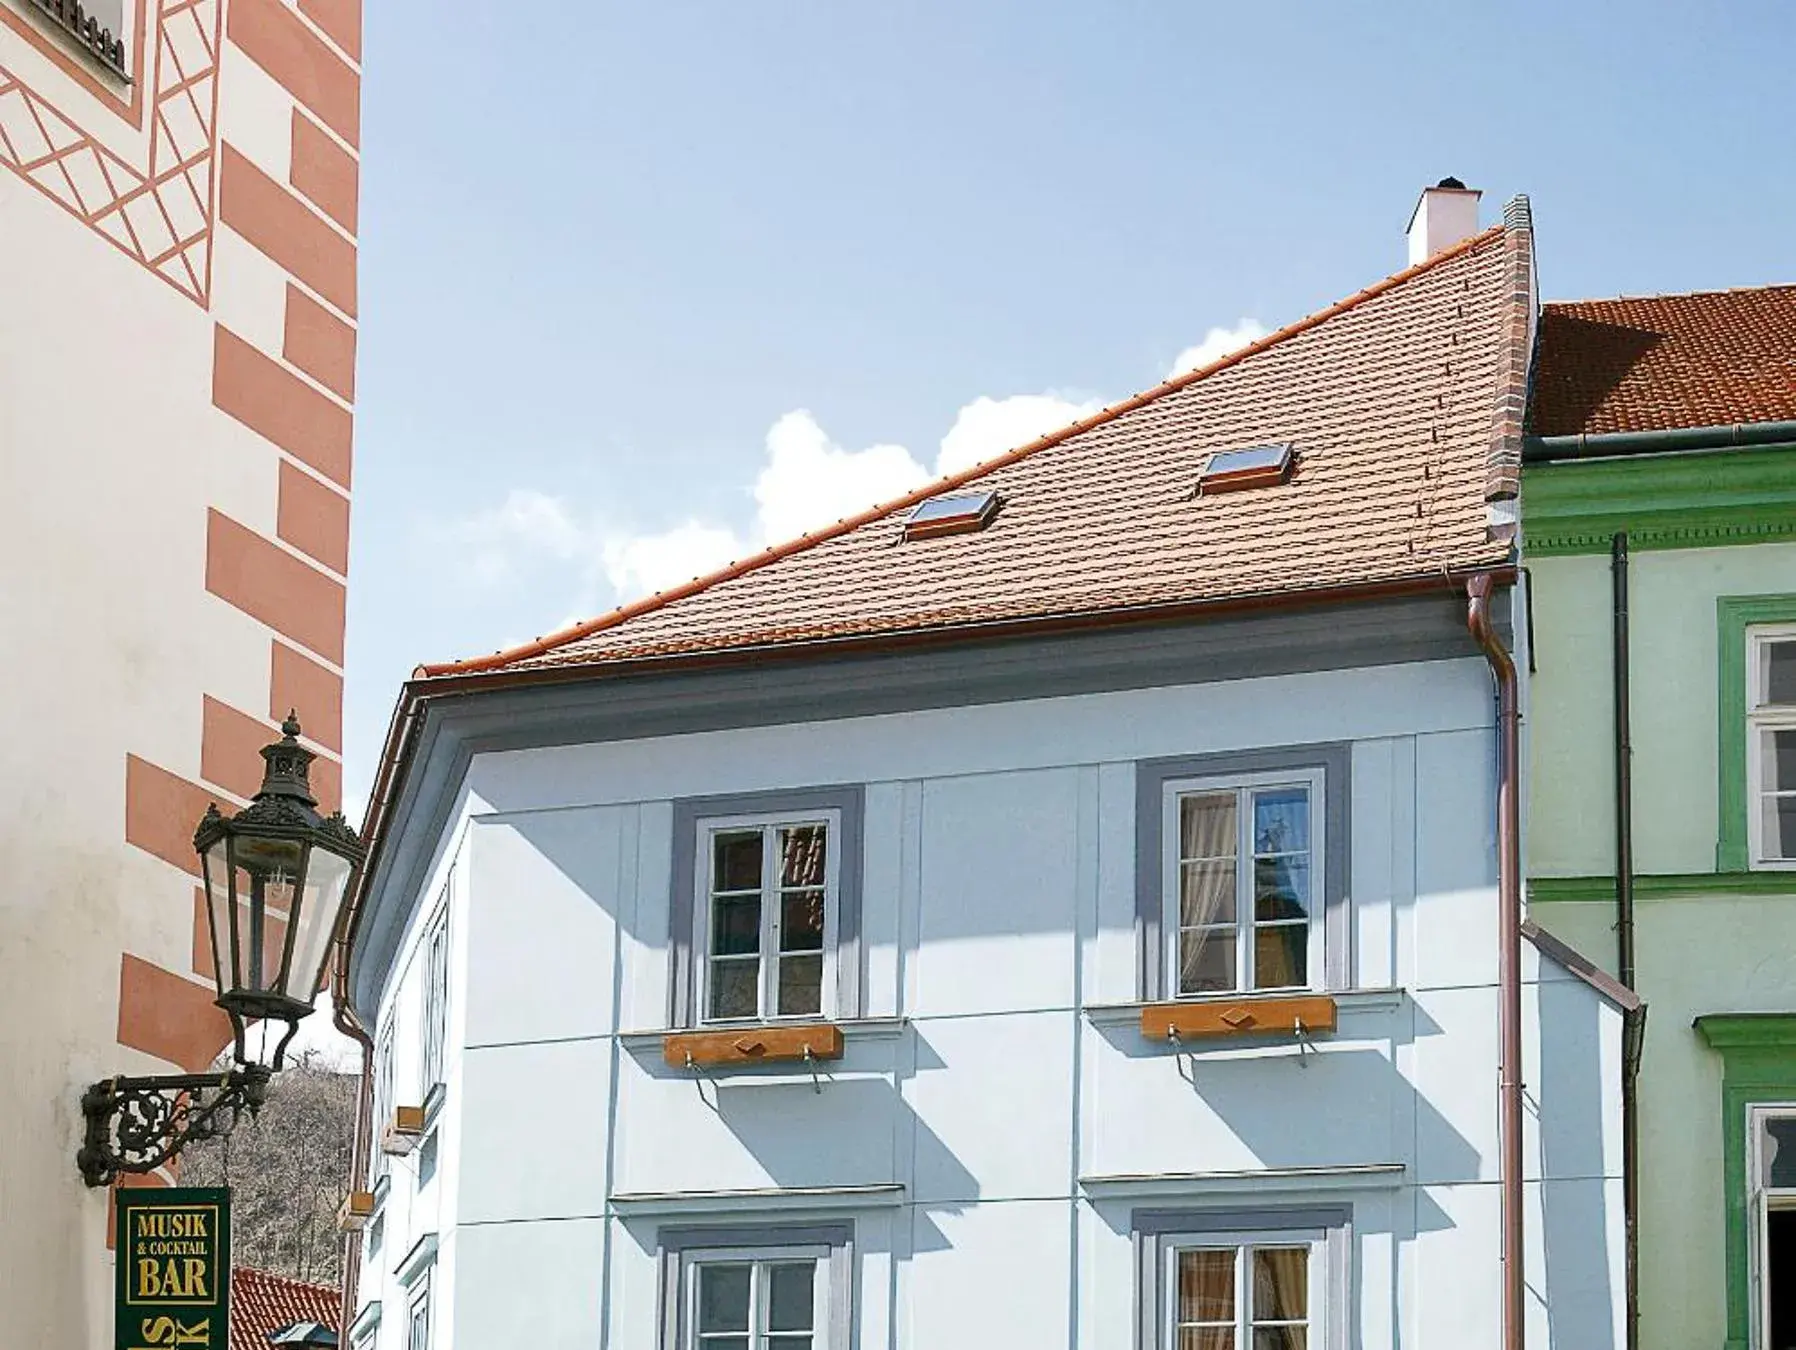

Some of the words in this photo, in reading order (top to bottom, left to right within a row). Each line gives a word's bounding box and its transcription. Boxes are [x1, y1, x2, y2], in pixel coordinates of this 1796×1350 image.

[138, 1213, 207, 1237] MUSIK
[137, 1241, 147, 1255] &
[150, 1241, 207, 1256] COCKTAIL
[138, 1258, 208, 1296] BAR
